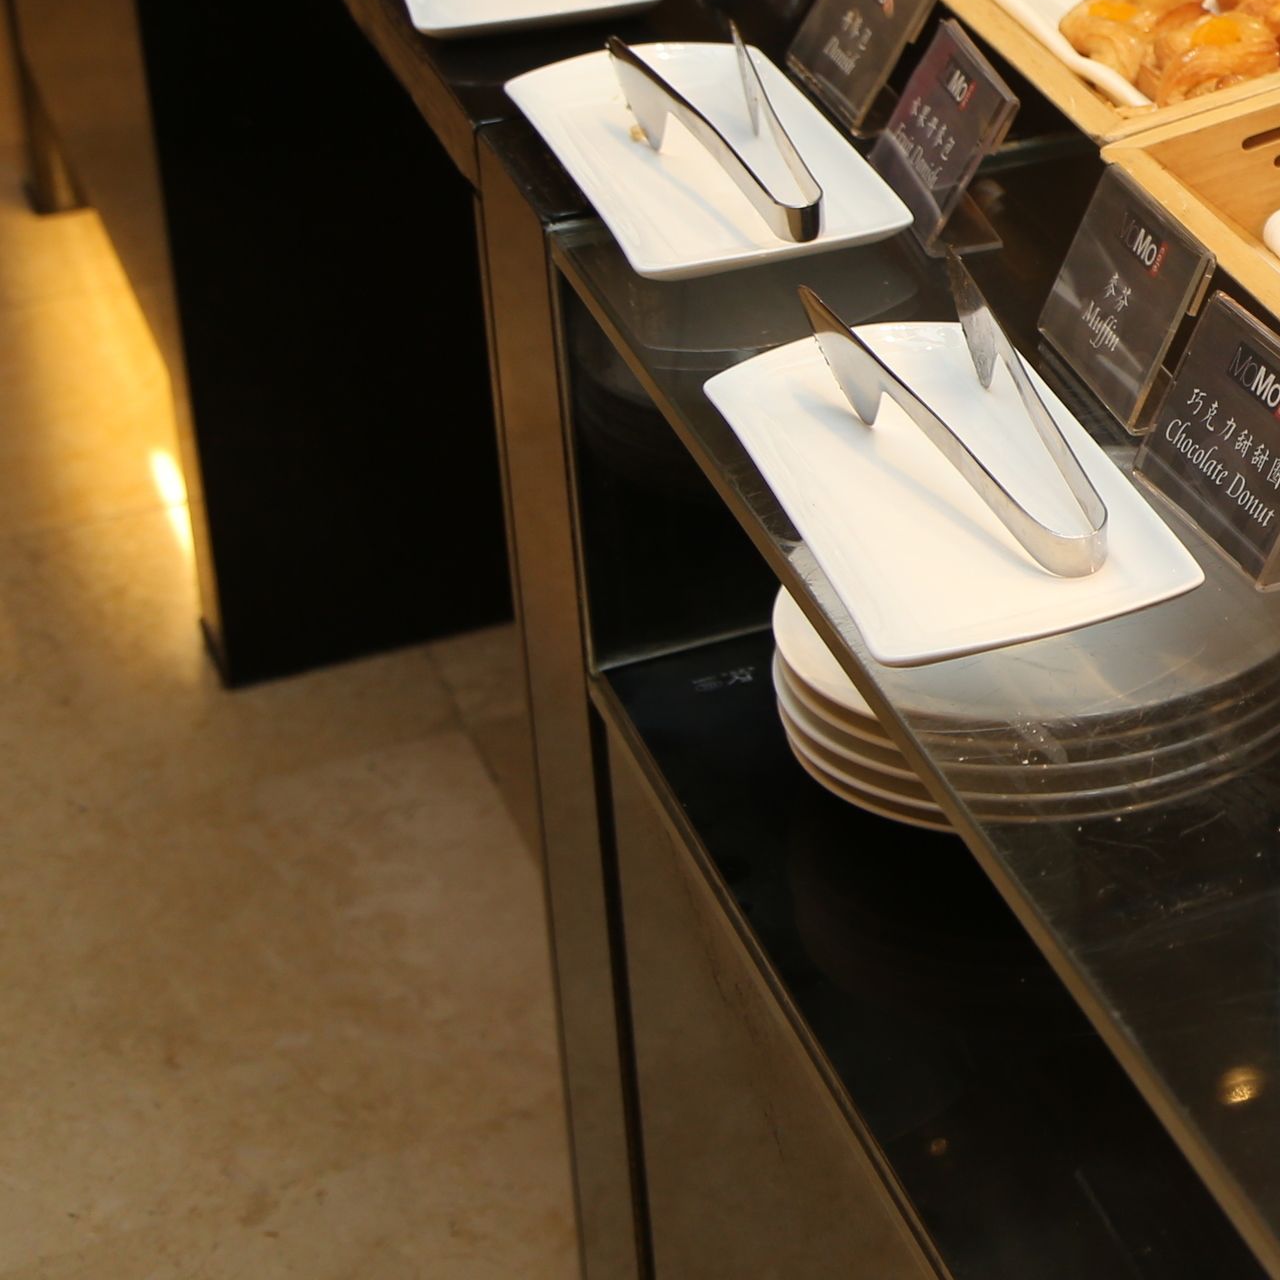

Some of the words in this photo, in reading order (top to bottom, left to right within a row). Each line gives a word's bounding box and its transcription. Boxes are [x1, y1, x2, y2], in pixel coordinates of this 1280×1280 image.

[1081, 300, 1120, 352] Muffin
[1165, 418, 1228, 486] Chocolate
[1226, 473, 1276, 528] Donut
